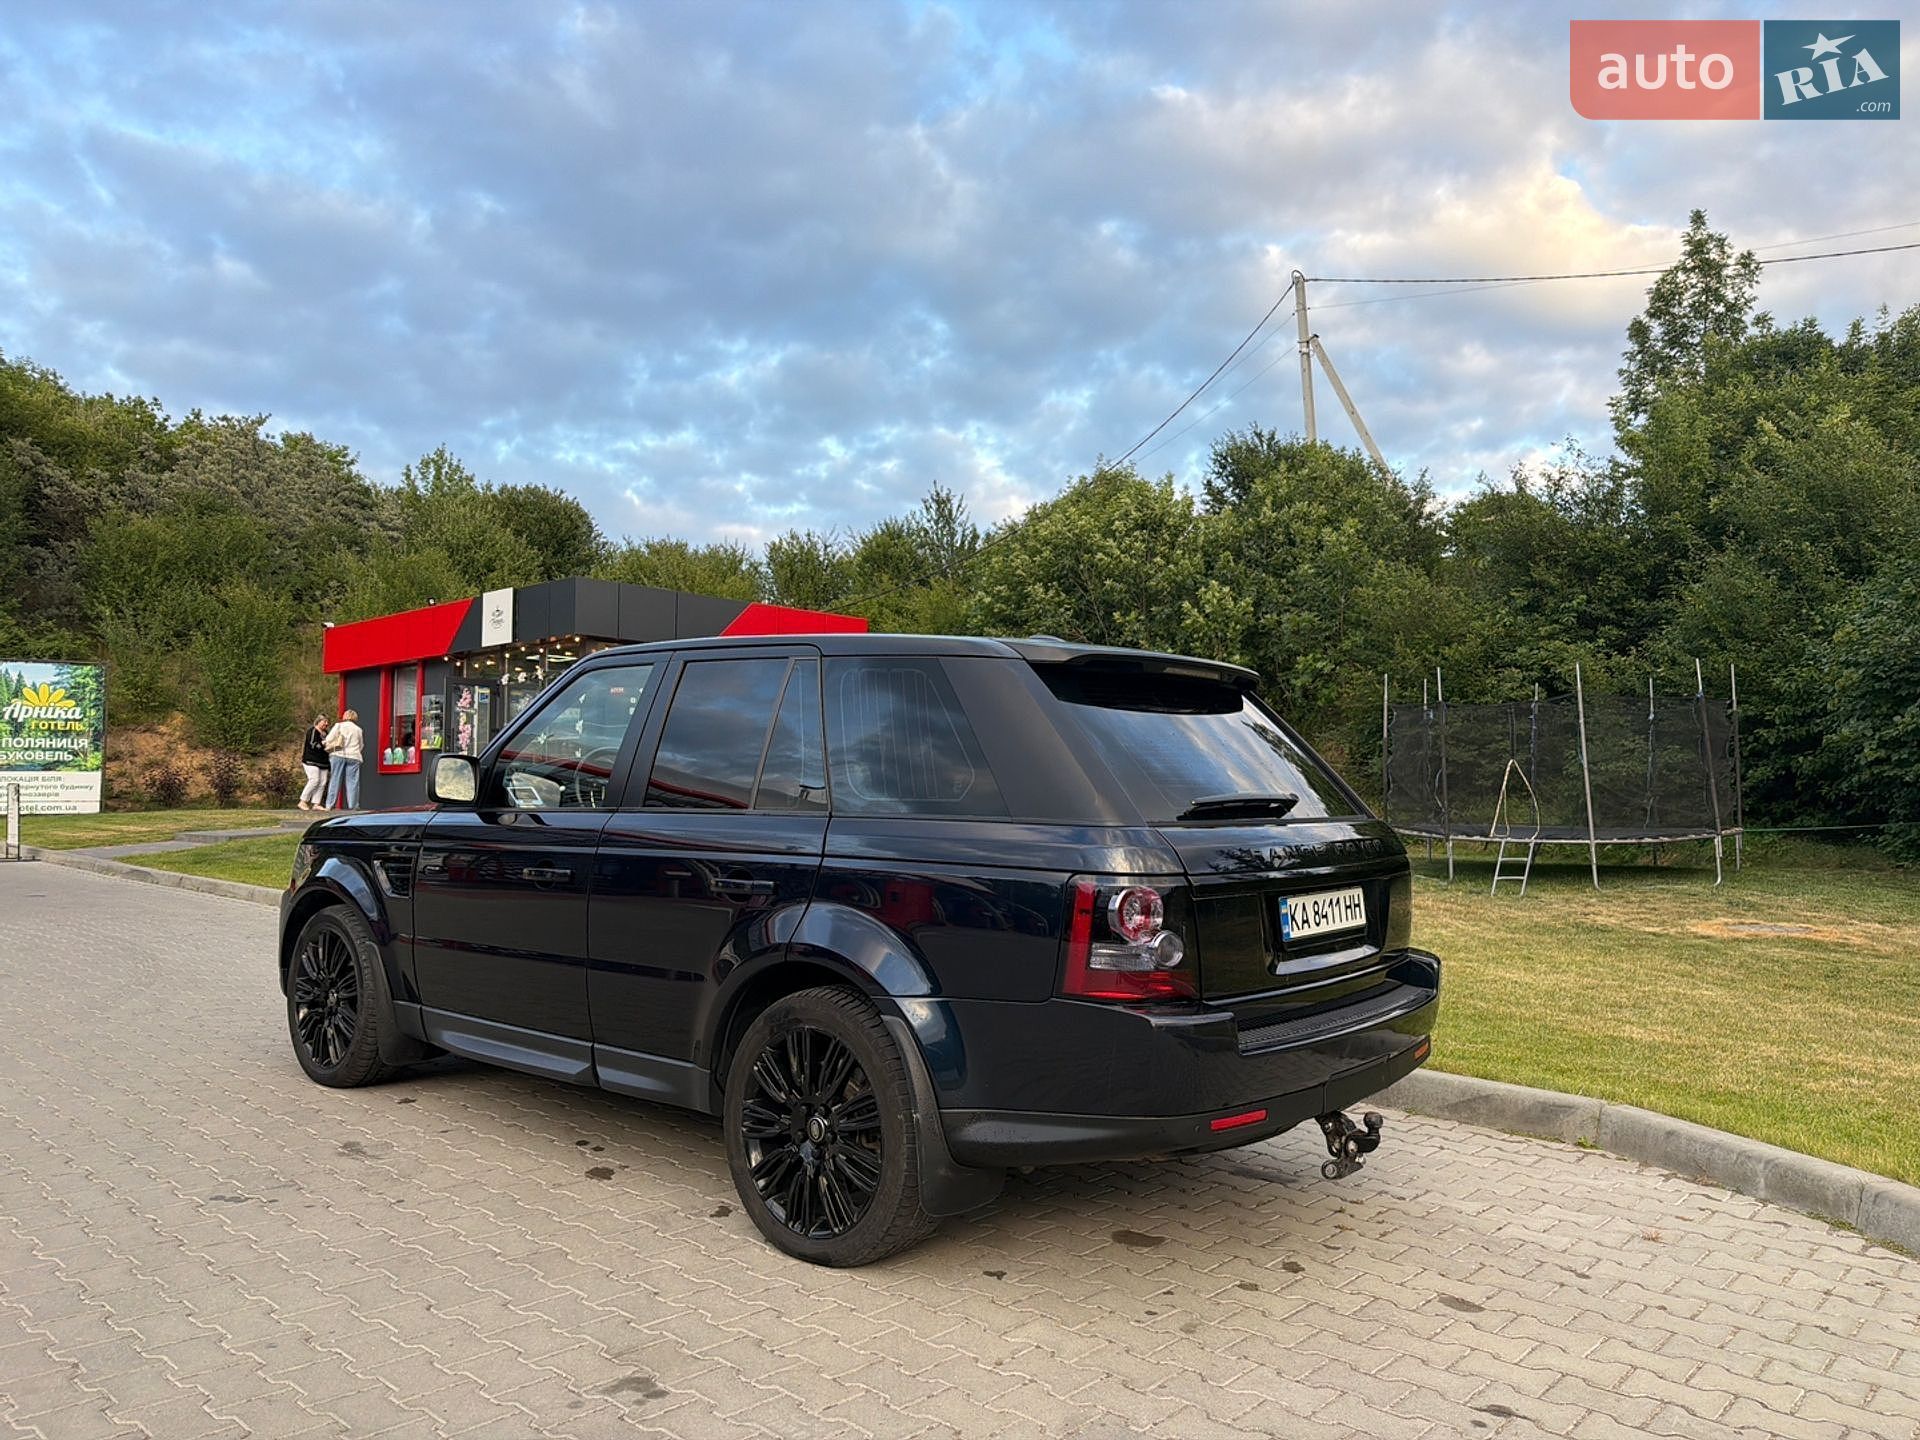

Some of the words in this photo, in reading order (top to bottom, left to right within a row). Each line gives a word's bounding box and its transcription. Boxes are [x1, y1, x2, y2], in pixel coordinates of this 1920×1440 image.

[3, 701, 84, 722] Арніка
[31, 720, 84, 731] ГОТЕЛЬ
[2, 737, 88, 750] ПОЛЯНИЦЯ
[1289, 902, 1311, 932] KA
[1313, 896, 1343, 928] 8411
[1343, 893, 1363, 922] HH
